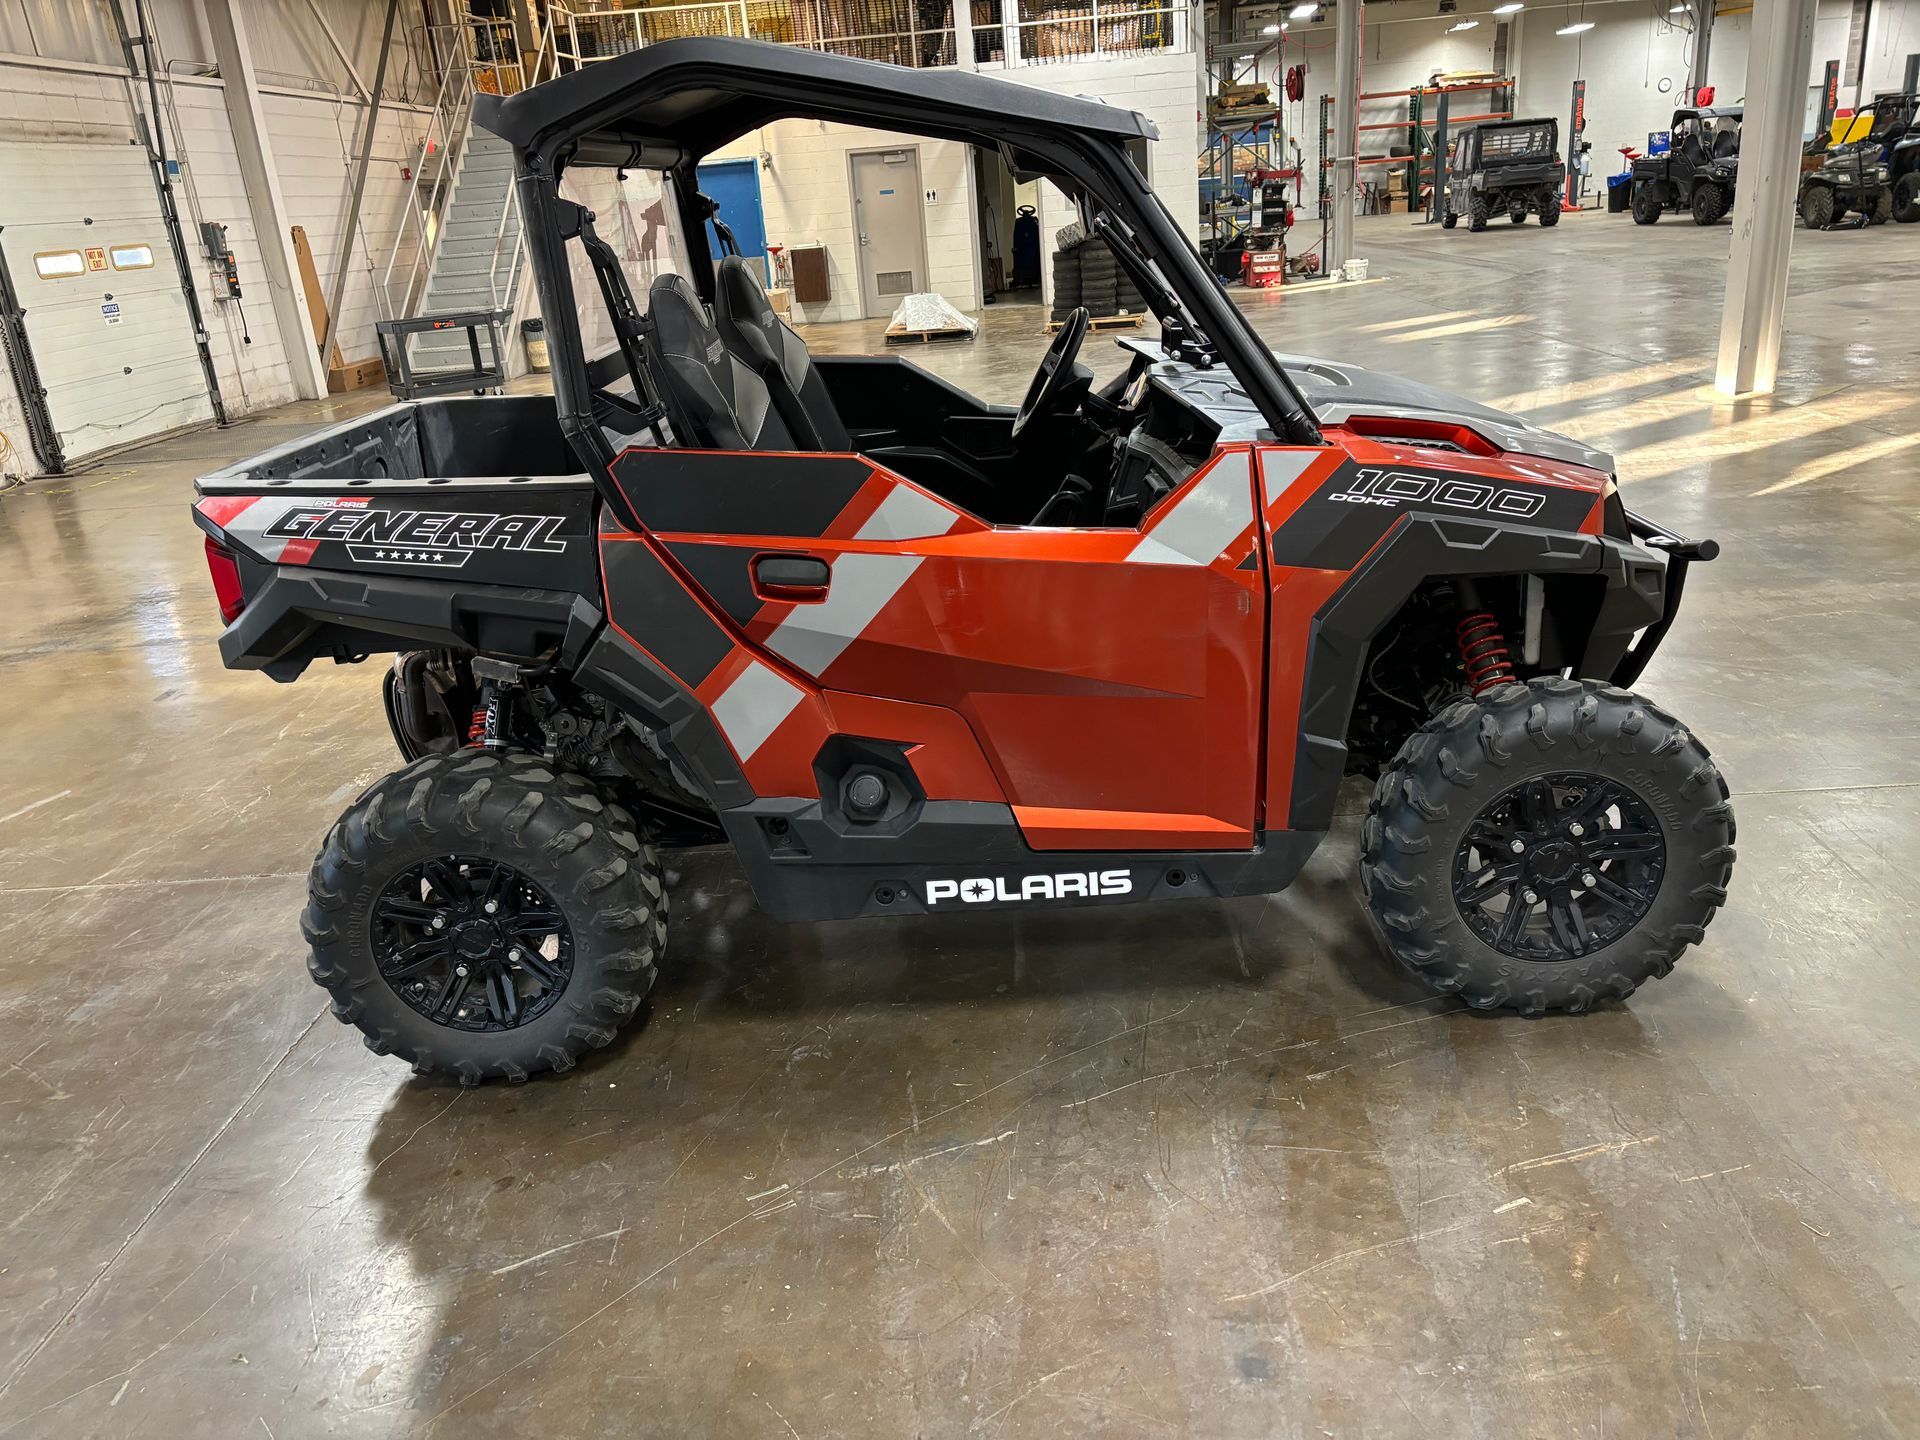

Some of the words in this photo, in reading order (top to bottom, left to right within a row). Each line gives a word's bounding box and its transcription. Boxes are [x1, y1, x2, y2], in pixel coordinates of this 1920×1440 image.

[1575, 97, 1583, 130] STRATUS
[88, 251, 96, 260] NOT
[97, 250, 104, 259] AN
[93, 260, 103, 269] EXIT
[103, 304, 119, 313] NOTICE
[314, 500, 369, 509] POLARIS
[1327, 492, 1400, 507] DOHC
[1347, 468, 1546, 518] 1000
[261, 506, 567, 553] GENERAL
[1623, 767, 1683, 832] CORONADO
[925, 869, 1133, 905] POLARIS
[350, 884, 373, 958] CORONADO
